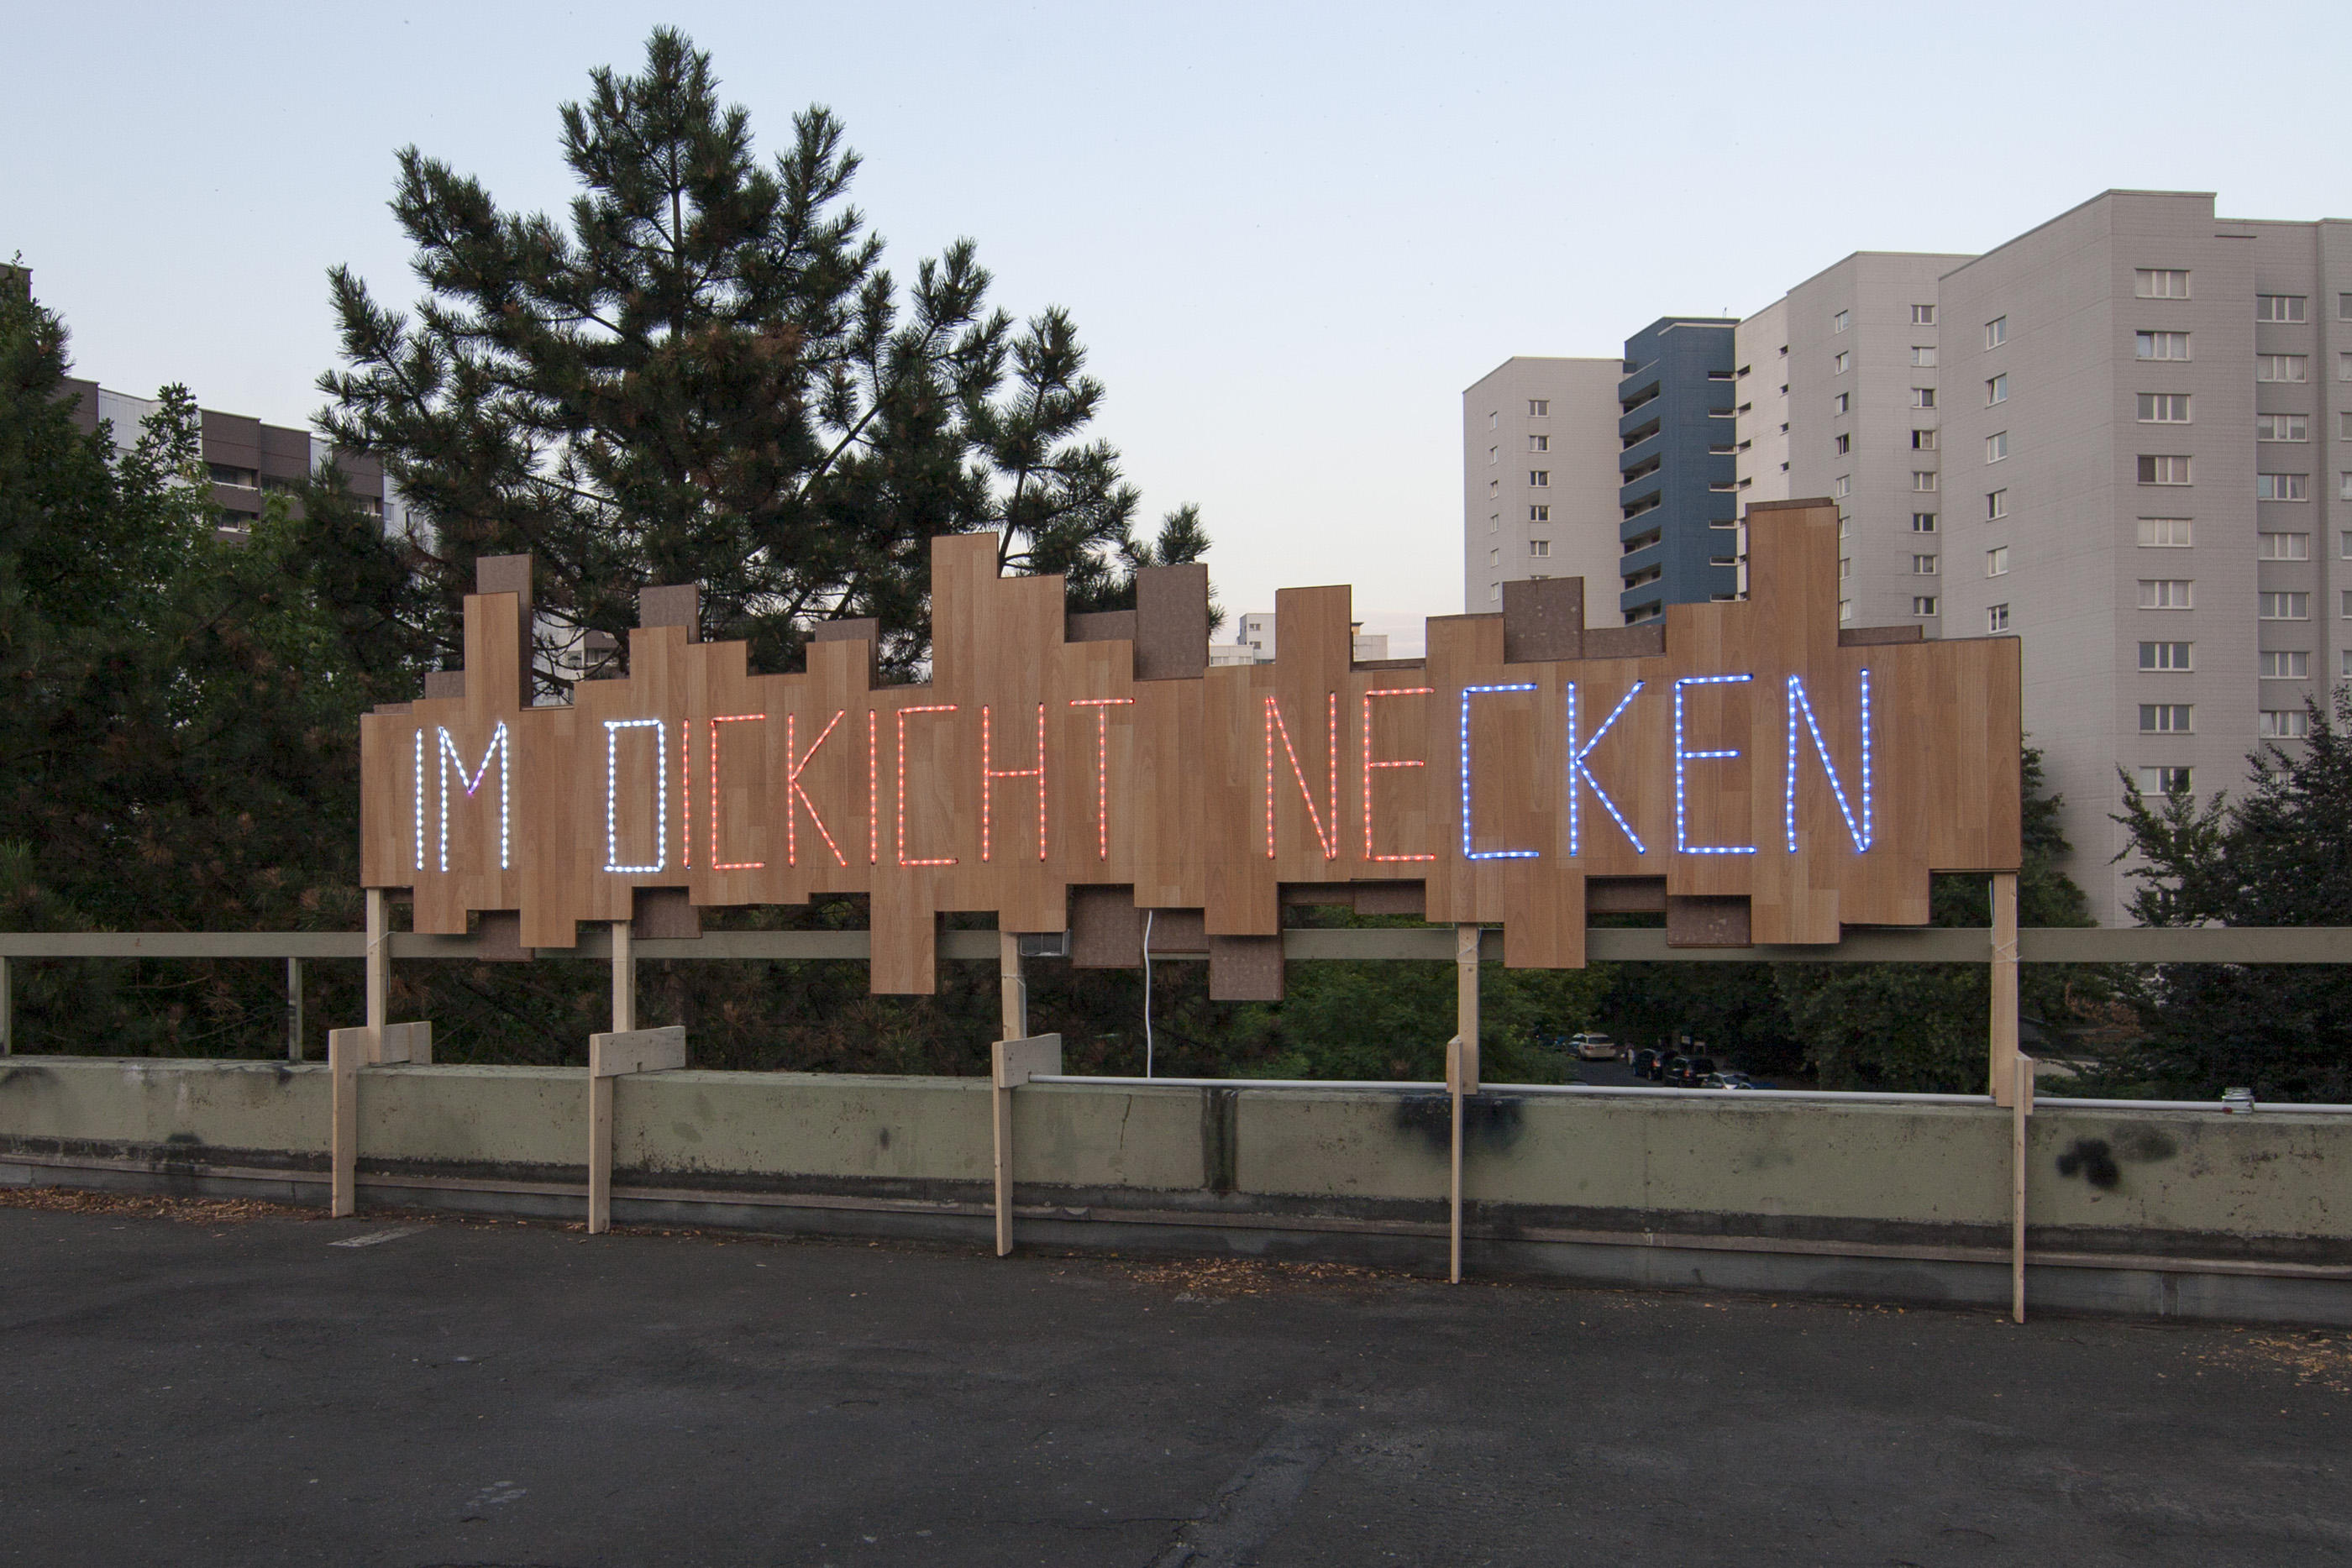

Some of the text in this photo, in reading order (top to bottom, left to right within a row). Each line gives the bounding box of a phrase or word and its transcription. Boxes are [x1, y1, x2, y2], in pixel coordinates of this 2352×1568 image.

[414, 669, 1870, 873] IM DICKICHT NECKEN
